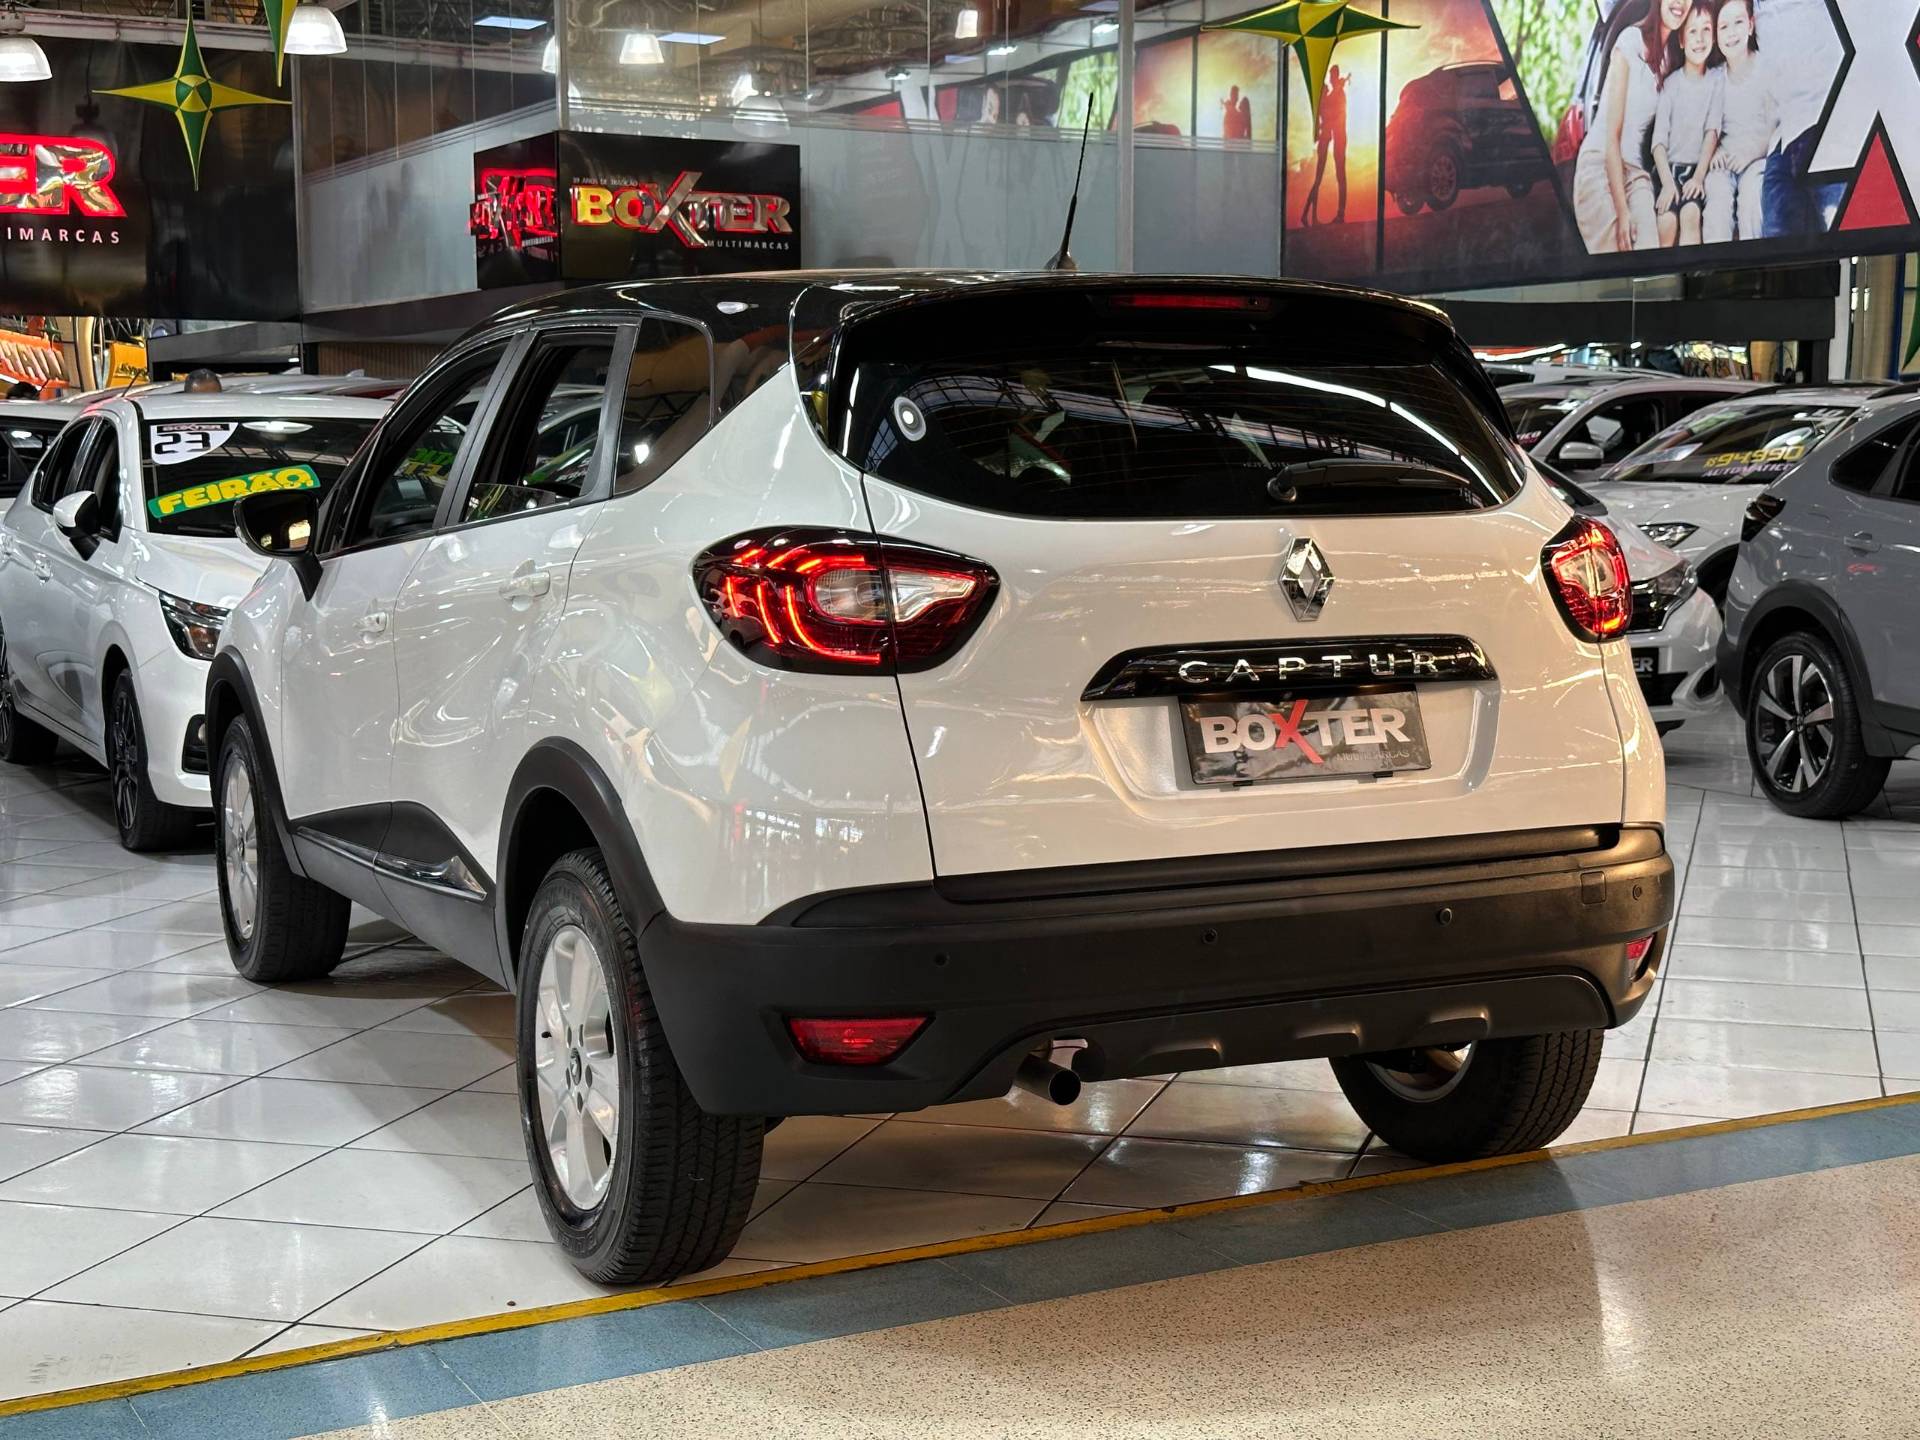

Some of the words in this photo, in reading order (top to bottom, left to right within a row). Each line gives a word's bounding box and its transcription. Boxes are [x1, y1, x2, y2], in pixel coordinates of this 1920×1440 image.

[570, 171, 793, 248] BOXTER
[707, 240, 790, 250] MULTIMARCAS
[153, 431, 212, 455] 23
[1178, 651, 1439, 683] CAPTUR
[1200, 700, 1411, 765] BOXTER
